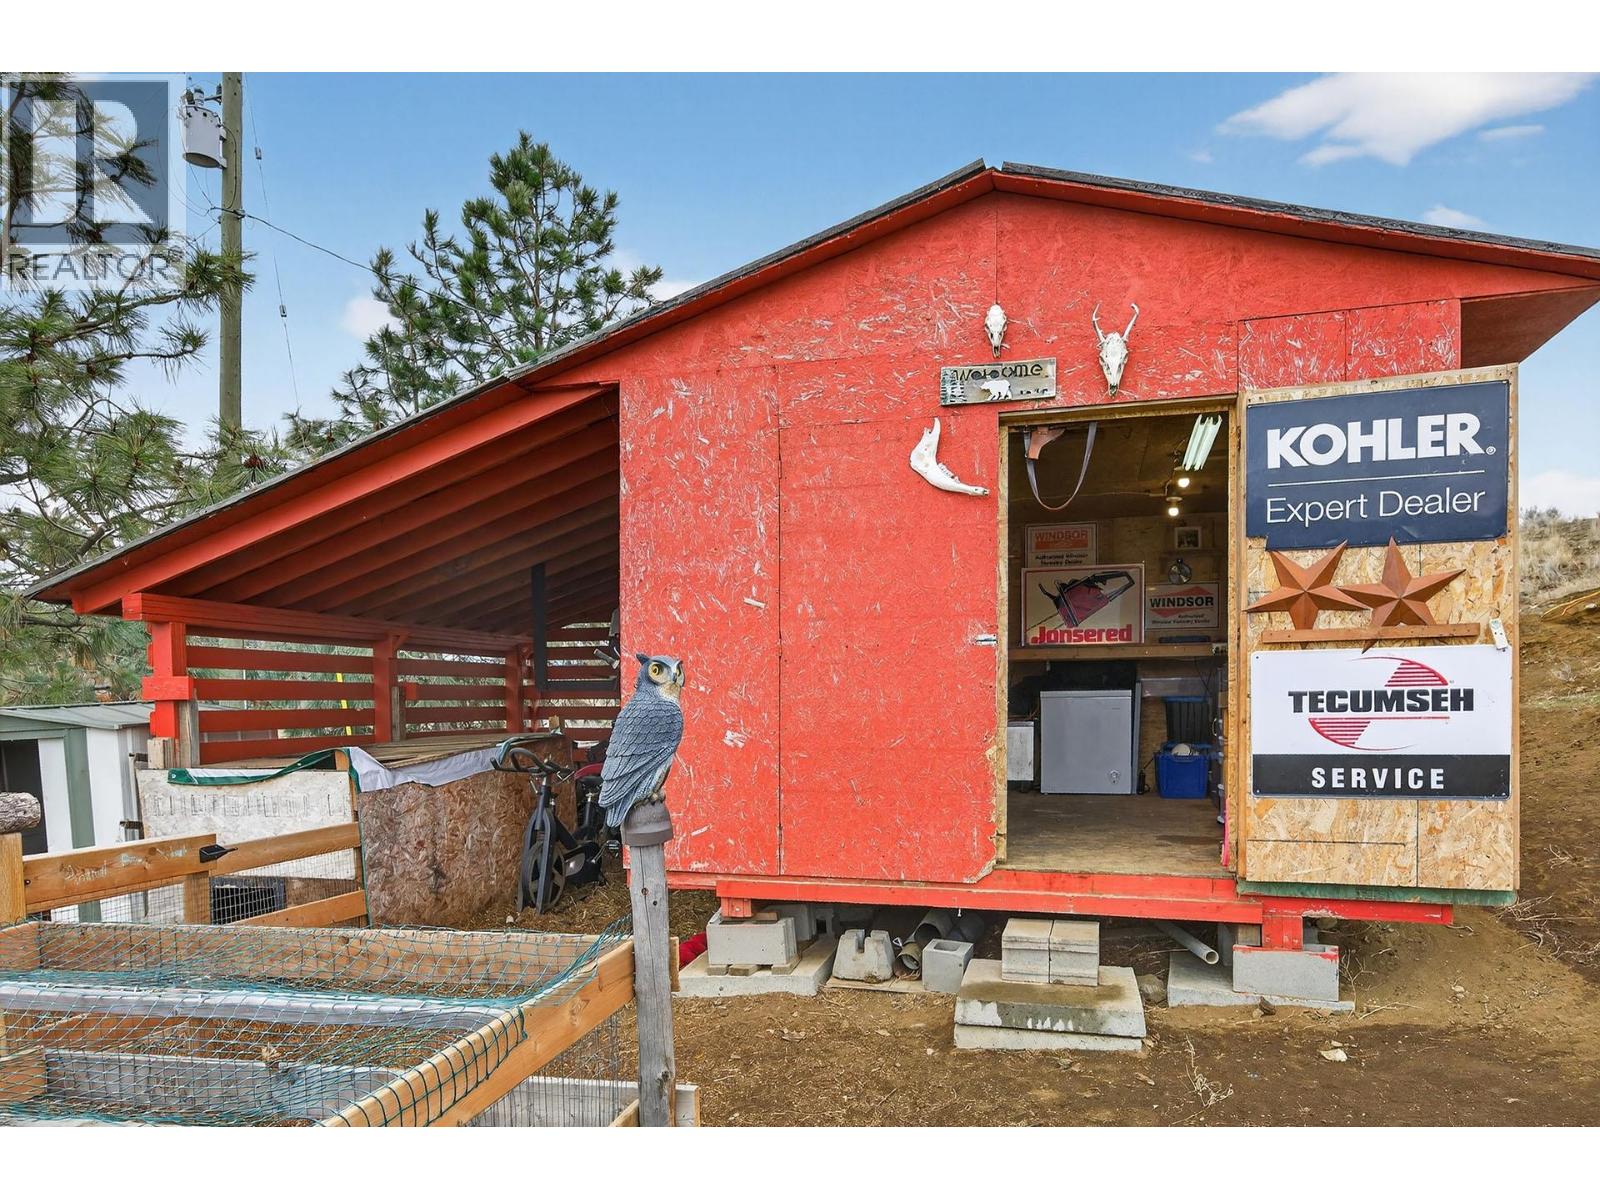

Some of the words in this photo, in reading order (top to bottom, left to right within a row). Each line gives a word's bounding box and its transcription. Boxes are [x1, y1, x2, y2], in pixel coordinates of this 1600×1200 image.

[1266, 494, 1368, 527] Expert
[1379, 487, 1486, 518] Dealer
[1150, 596, 1214, 608] WINDSOR
[1031, 623, 1133, 644] Jonsered
[1288, 688, 1474, 713] TECUMSEH
[1311, 767, 1445, 790] SERVICE
